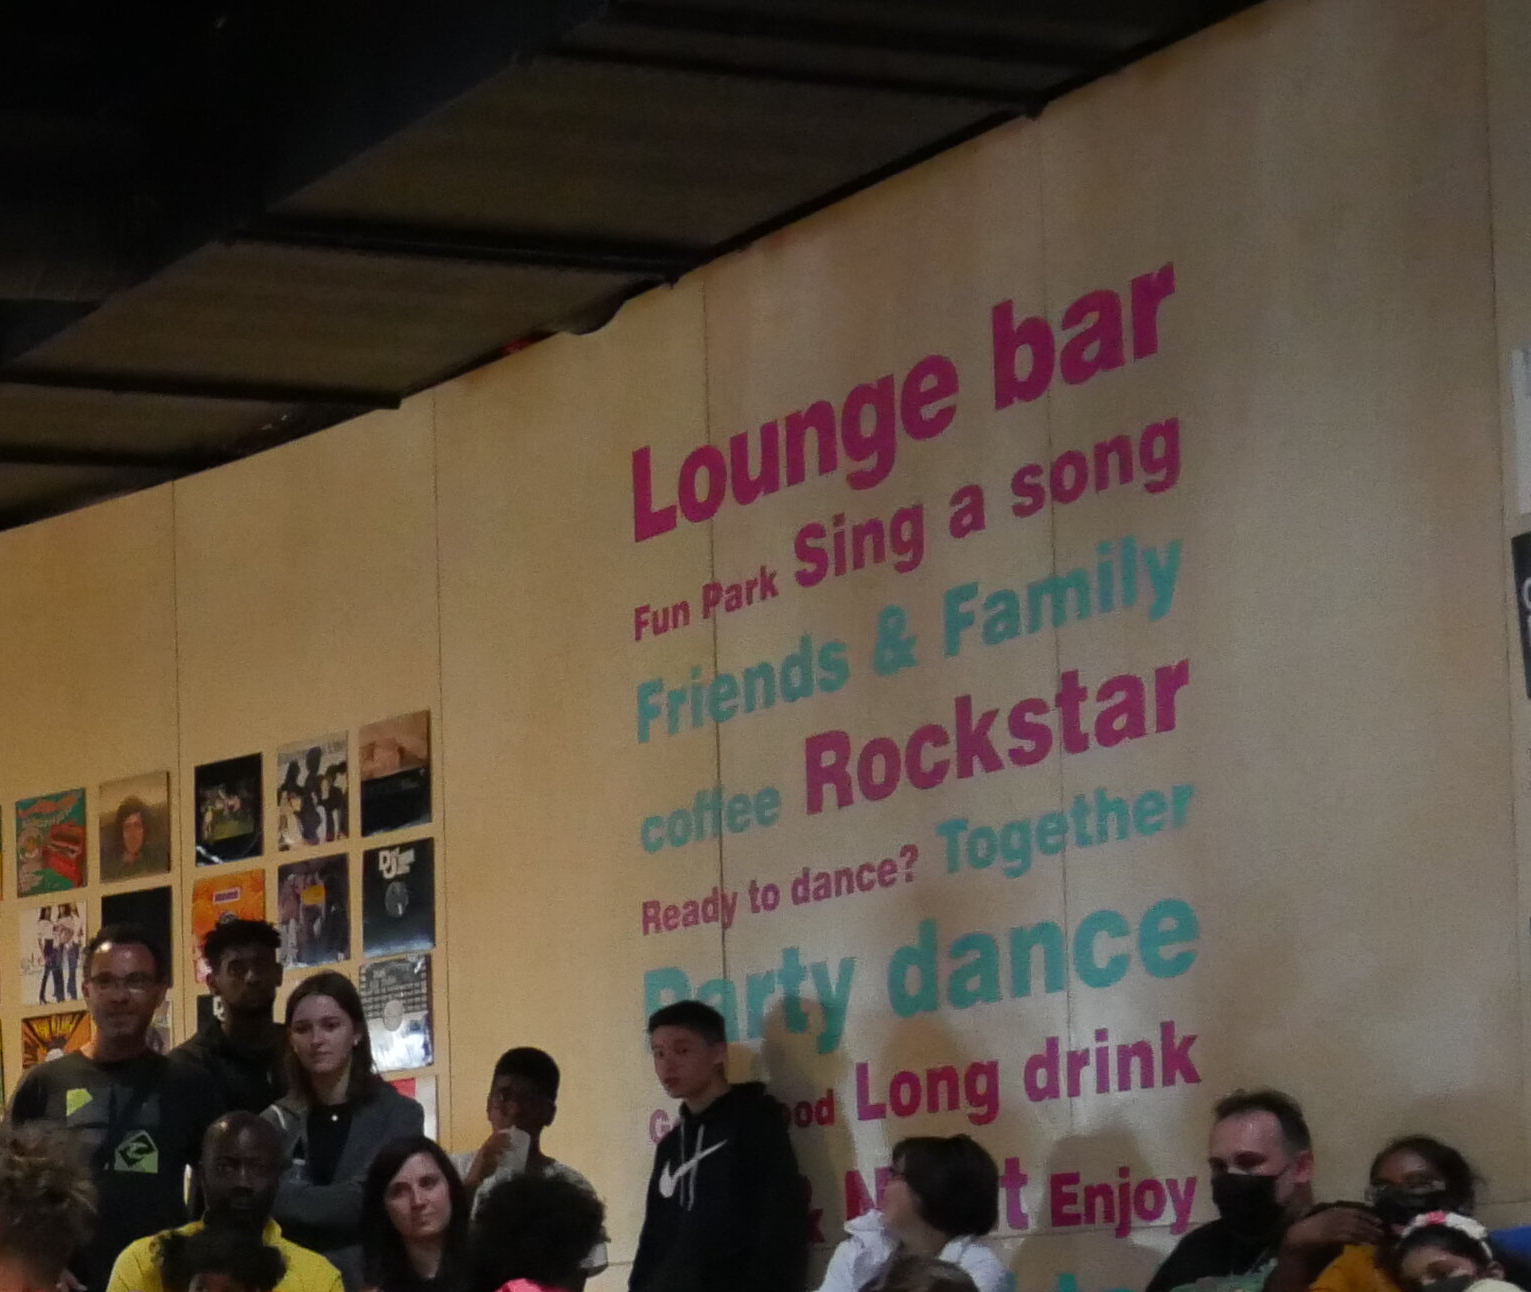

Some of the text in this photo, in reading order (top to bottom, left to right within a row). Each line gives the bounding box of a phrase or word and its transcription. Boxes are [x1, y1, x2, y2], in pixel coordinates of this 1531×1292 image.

[631, 262, 1177, 543] Lounge bar
[634, 417, 1182, 641] Fun Park Sing a song
[637, 534, 1183, 743] Friends & Family
[641, 659, 1191, 854] coffee Rockstar
[642, 784, 1197, 935] Ready to dance? Together
[643, 898, 1200, 1055] Party dance
[856, 1060, 1001, 1126] Long
[1023, 1020, 1202, 1102] drink
[1049, 1166, 1197, 1239] Enjoy
